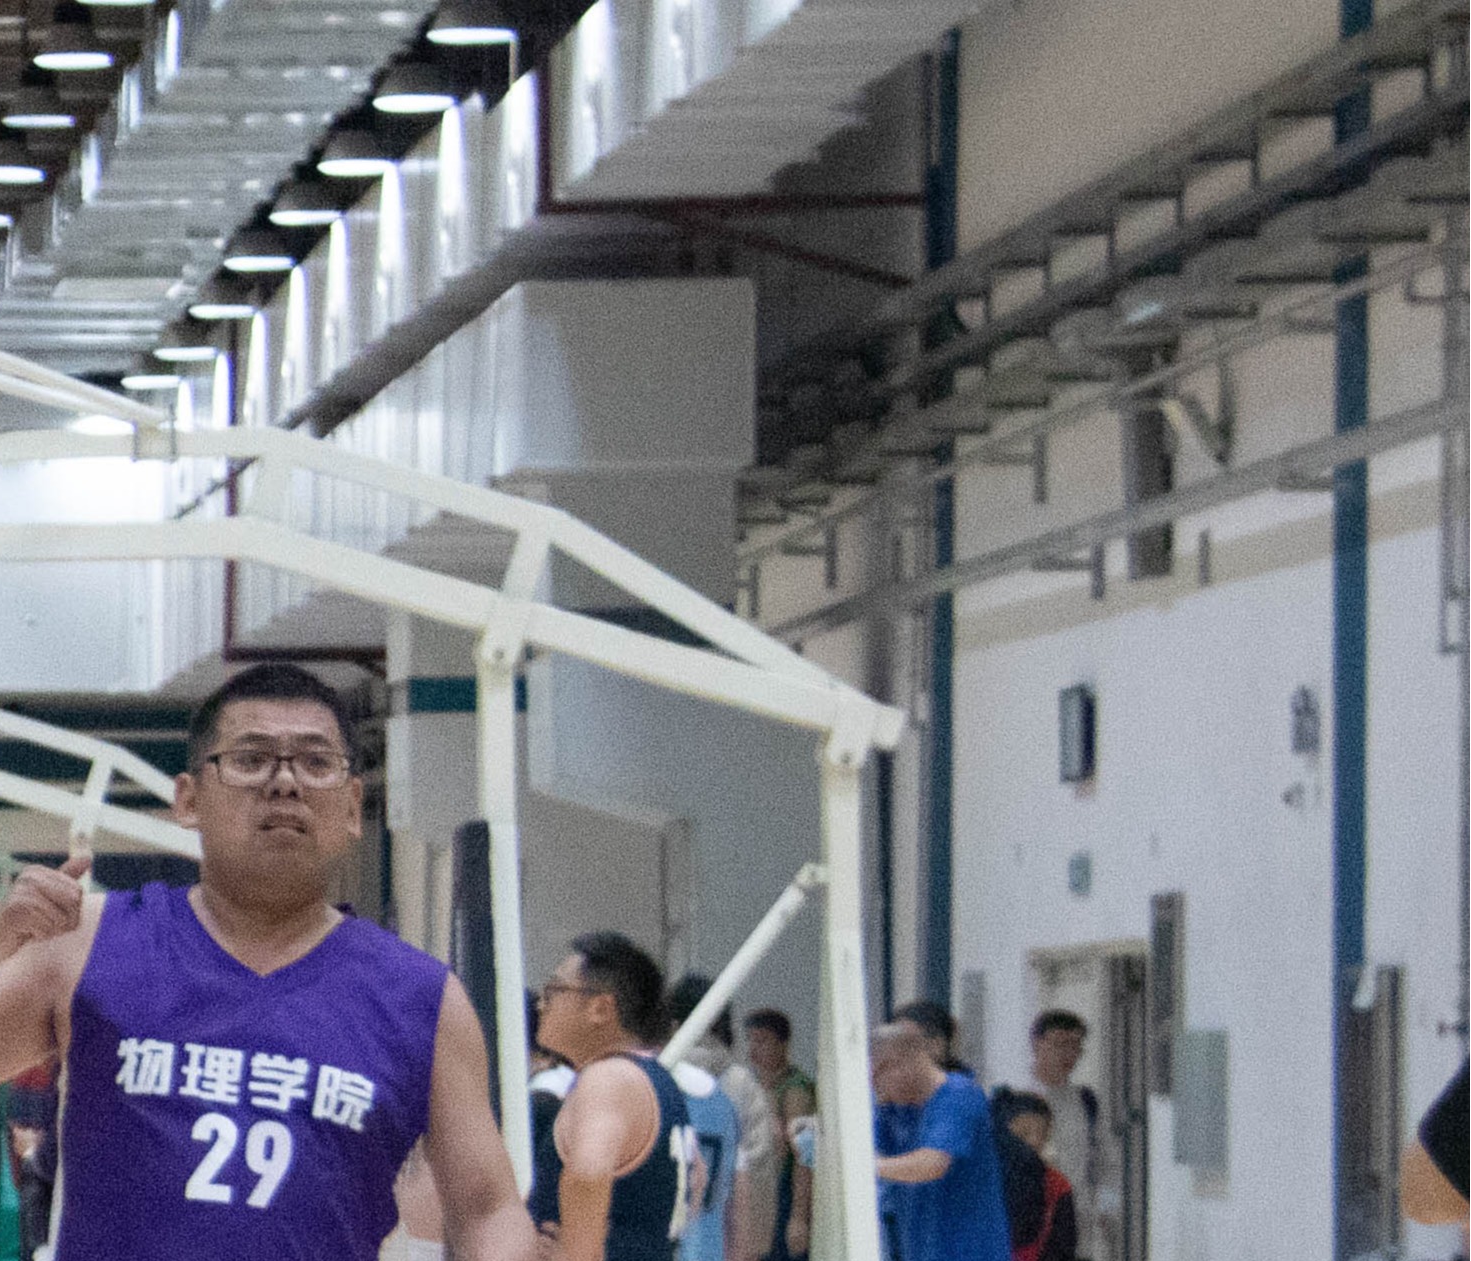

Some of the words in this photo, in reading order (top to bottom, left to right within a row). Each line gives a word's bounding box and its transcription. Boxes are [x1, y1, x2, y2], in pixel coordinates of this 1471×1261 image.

[115, 1038, 374, 1132] 物理学院
[185, 1112, 294, 1210] 29
